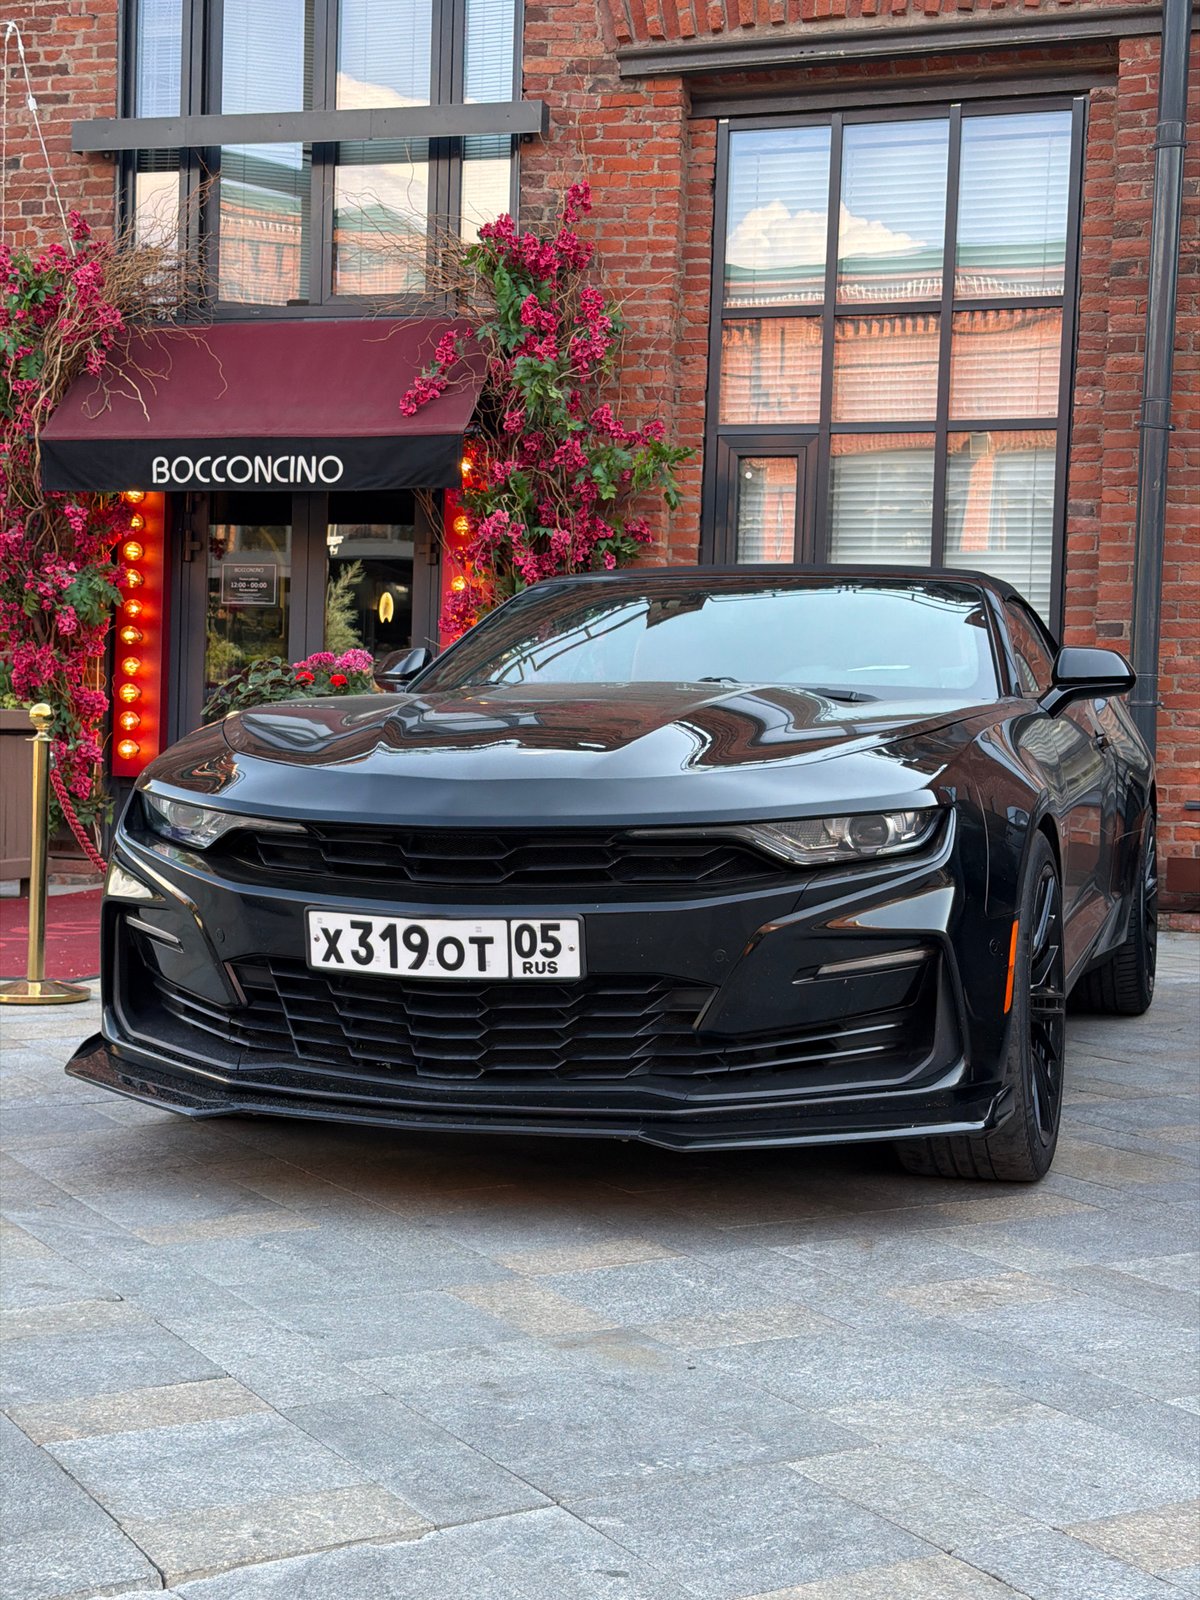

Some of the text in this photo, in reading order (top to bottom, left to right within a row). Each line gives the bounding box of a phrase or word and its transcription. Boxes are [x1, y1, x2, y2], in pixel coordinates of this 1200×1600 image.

[152, 455, 344, 483] BOCCONCINO
[514, 923, 562, 959] 05
[522, 961, 558, 974] RUS
